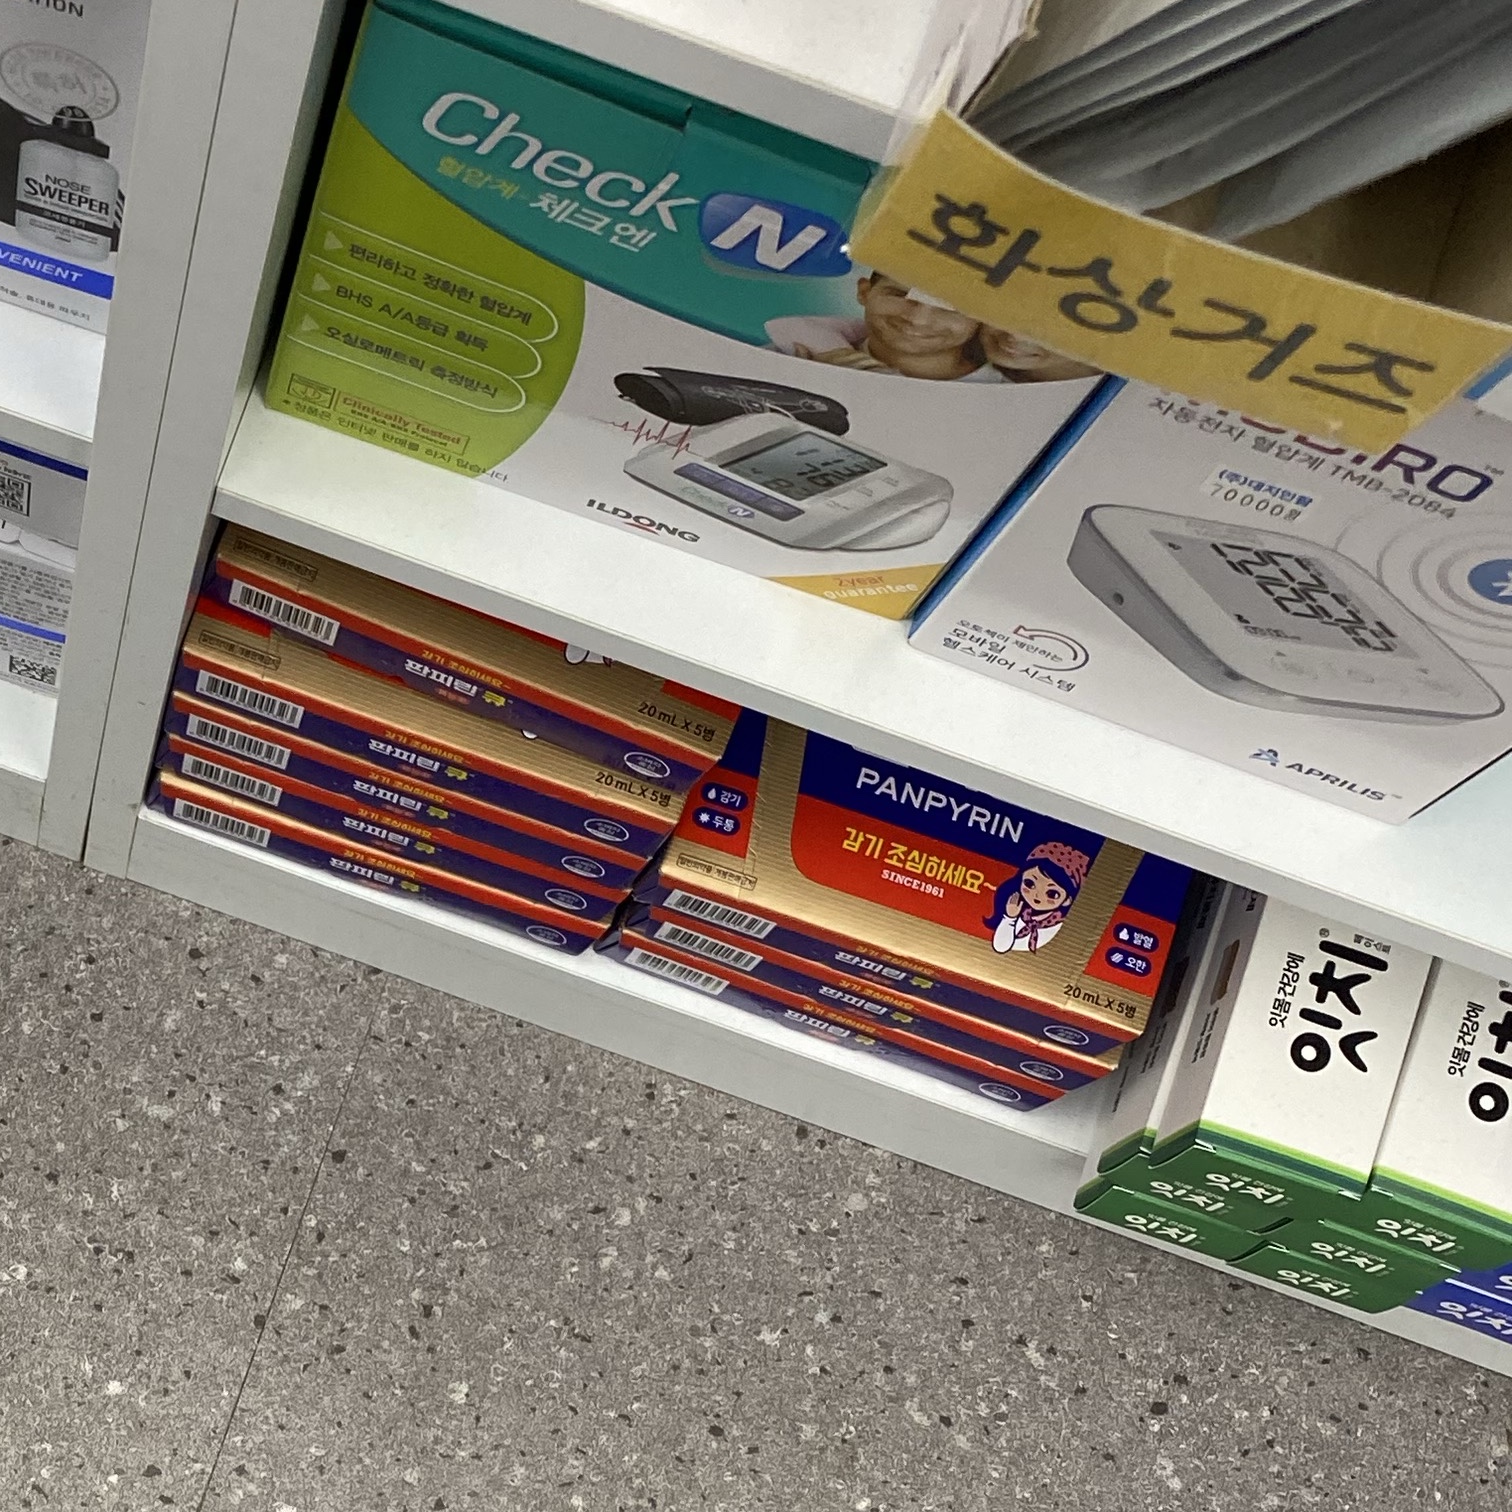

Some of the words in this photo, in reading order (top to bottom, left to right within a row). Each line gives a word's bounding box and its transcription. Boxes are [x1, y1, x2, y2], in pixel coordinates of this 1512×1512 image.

[24, 177, 109, 216] SWEEPER
[45, 174, 91, 195] NOSE
[422, 91, 700, 232] Check
[710, 204, 826, 270] N
[530, 192, 657, 252] 체크엔
[349, 243, 417, 281] 편리하고
[423, 273, 475, 304] 정확한
[480, 295, 532, 326] 혈압계
[336, 285, 373, 308] BHS
[379, 303, 449, 337] A/A등급
[455, 330, 488, 351] 획득
[906, 193, 1435, 414] 화상거즈
[325, 326, 425, 371] 오실로메트릭
[430, 366, 498, 398] 측정방식
[343, 397, 409, 428] Clinically
[295, 400, 332, 421] 정품은
[338, 418, 377, 437] 인터넷
[382, 432, 420, 452] 판매를
[425, 447, 451, 464] 하지
[1148, 396, 1247, 442] 자동전자
[1251, 435, 1325, 472] 혈압계
[1331, 464, 1457, 520] TMB-2084
[587, 499, 700, 543] ILDONG
[822, 580, 918, 600] guarantee
[949, 628, 1006, 655] 모바일
[404, 659, 478, 697] 판피린
[943, 637, 1016, 671] 헬스케어
[1019, 667, 1075, 692] 시스템
[637, 701, 657, 718] 20
[658, 708, 679, 730] mL
[680, 718, 694, 733] X
[694, 723, 716, 743] 5병
[368, 738, 441, 772] 판피린
[353, 780, 422, 812] 판피린
[595, 771, 613, 786] 20
[615, 779, 635, 795] mL
[638, 785, 651, 799] X
[650, 790, 671, 808] 5병
[1285, 762, 1386, 801] APRILIS
[720, 790, 742, 808] 감기
[856, 766, 1024, 843] PANPYRIN
[342, 816, 409, 847] 판피린
[712, 815, 735, 832] 두통
[329, 857, 395, 886] 판피린
[842, 827, 884, 860] 감기
[884, 841, 998, 894] 조심하세요~
[881, 869, 945, 898] SINCE1961
[1132, 931, 1154, 950] 발열
[834, 951, 907, 981] 판피린
[1125, 956, 1147, 973] 오한
[1278, 951, 1305, 997] 건강에
[818, 985, 889, 1016] 판피린
[1063, 983, 1081, 998] 20
[1083, 990, 1101, 1006] mL
[1102, 998, 1115, 1011] X
[1116, 1000, 1136, 1019] 5병
[1269, 997, 1291, 1028] 잇몸
[1290, 939, 1389, 1073] 잇치
[783, 1009, 851, 1038] 판피린
[1457, 1001, 1485, 1047] 건강에
[1447, 1047, 1471, 1078] 잇몸
[1150, 1181, 1226, 1212] 잇치
[1205, 1173, 1285, 1204] 잇치
[1124, 1214, 1197, 1243] 잇치
[1374, 1218, 1456, 1252] 잇치
[1310, 1242, 1387, 1273] 잇치
[1277, 1269, 1351, 1297] 잇치
